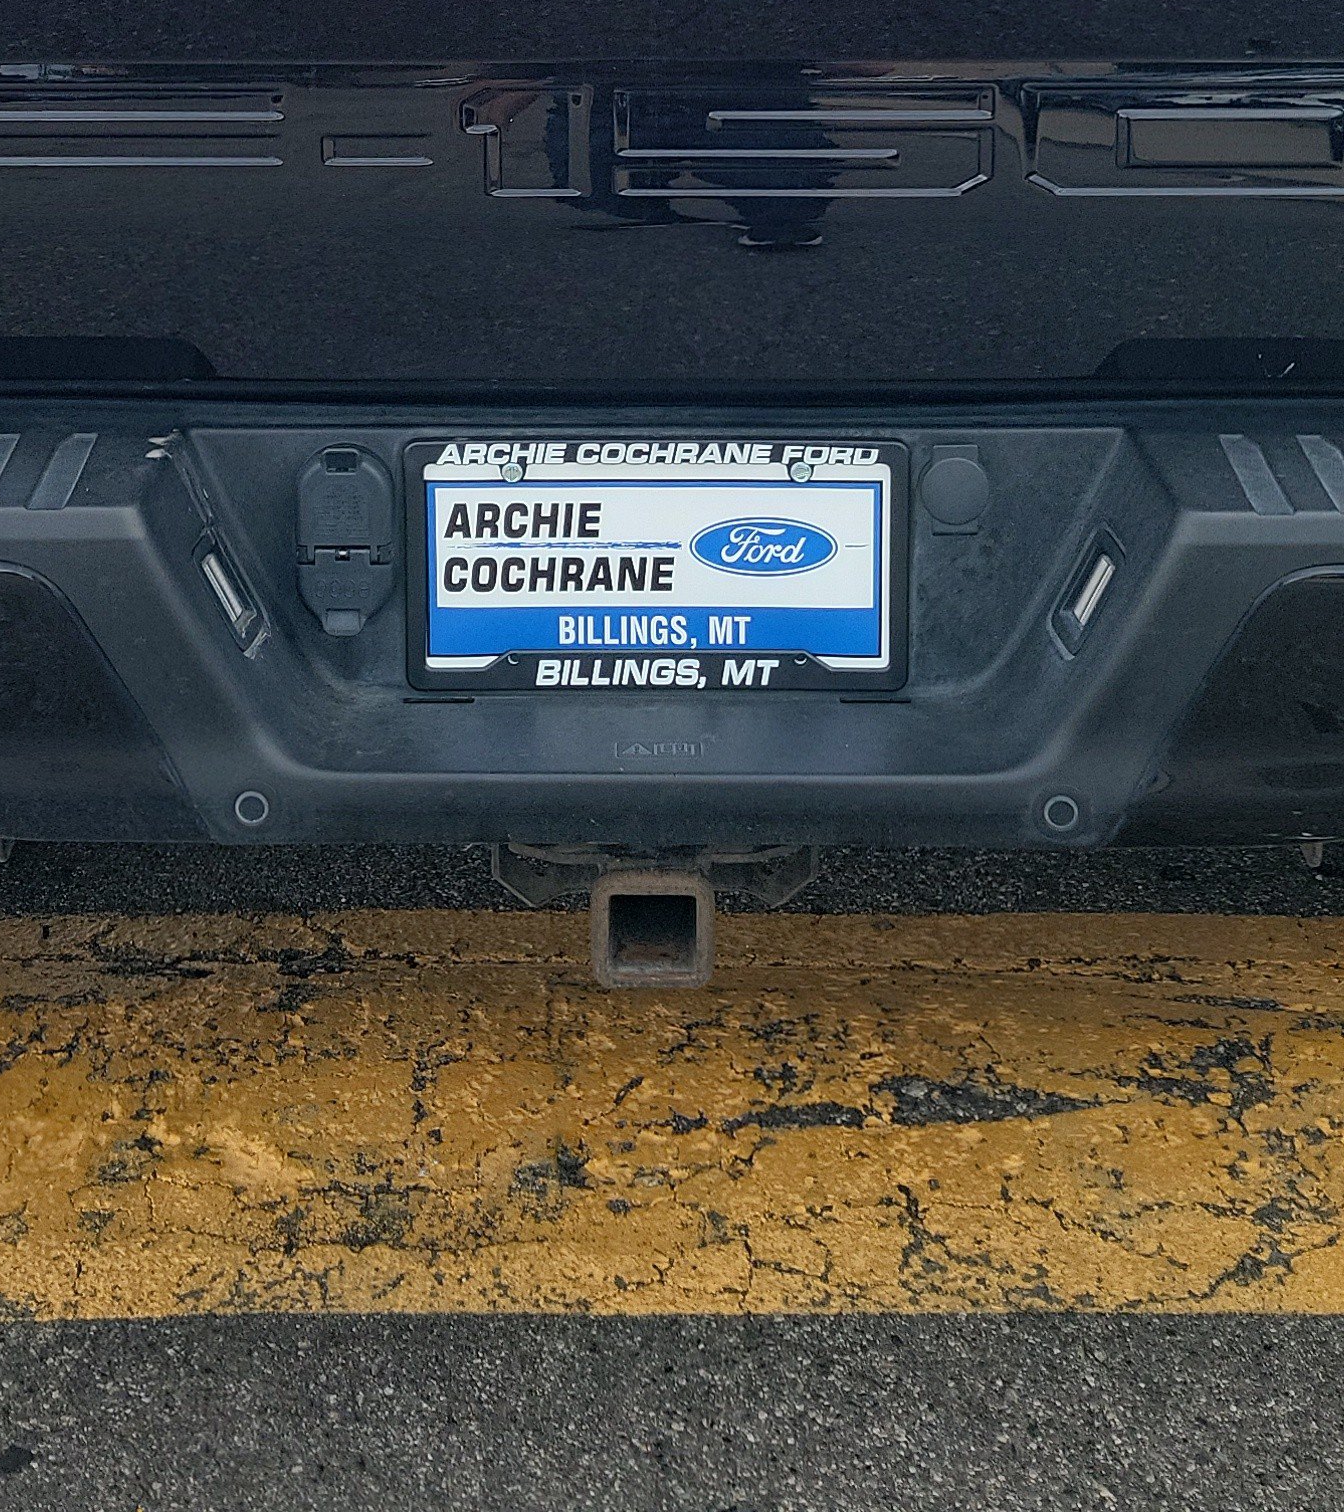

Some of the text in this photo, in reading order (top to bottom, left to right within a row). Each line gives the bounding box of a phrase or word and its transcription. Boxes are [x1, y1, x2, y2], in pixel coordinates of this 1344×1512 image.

[436, 442, 879, 466] ARCHIE COCHRANE FORD
[443, 502, 603, 540] ARCHIE
[719, 527, 807, 565] Ford
[443, 556, 676, 593] COCHRANE
[558, 615, 752, 649] BILLINGS, MT
[535, 658, 780, 689] BILLINGS, MT
